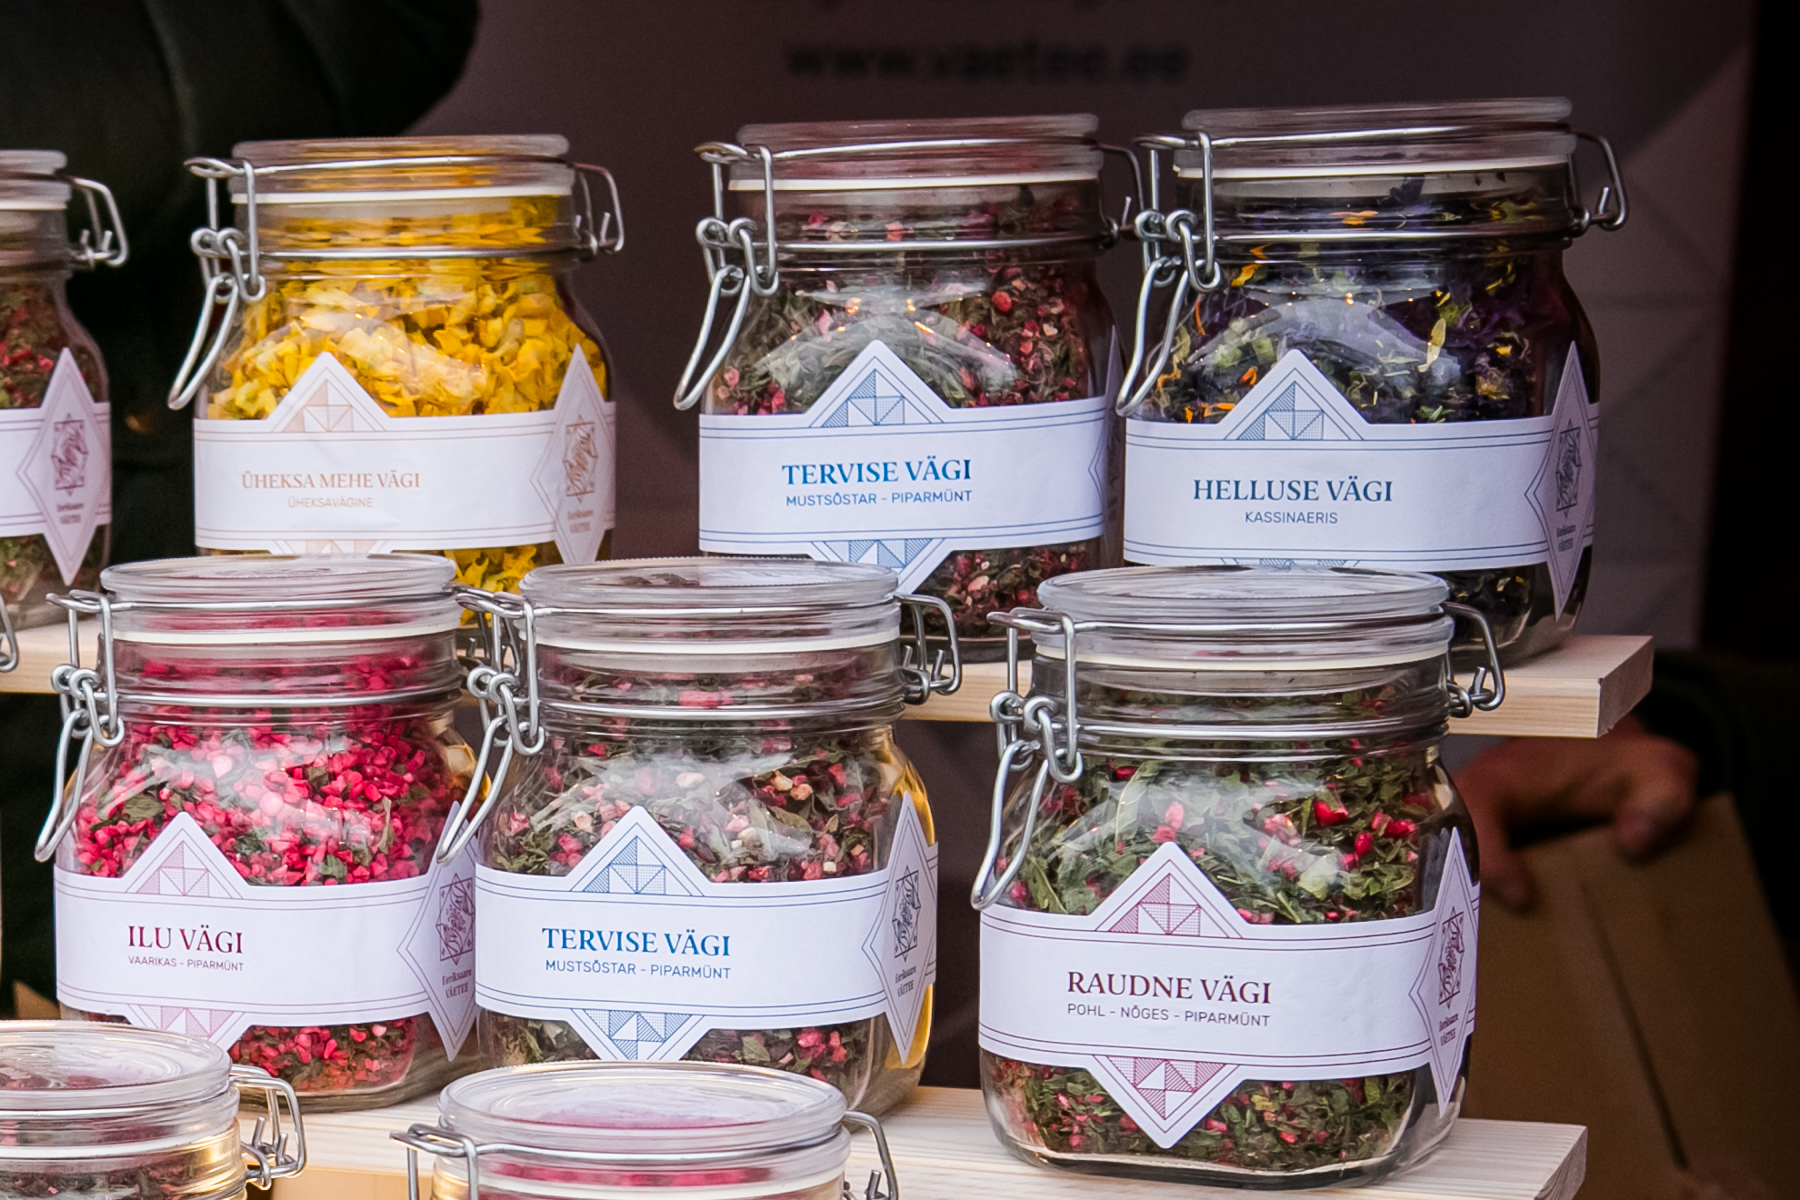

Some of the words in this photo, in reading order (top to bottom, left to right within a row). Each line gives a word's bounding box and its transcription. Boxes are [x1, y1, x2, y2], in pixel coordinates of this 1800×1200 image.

[242, 471, 315, 489] ÜHEKSA
[319, 473, 373, 489] MEHE
[377, 471, 420, 489] VÄGI
[782, 460, 898, 485] TERVISE
[907, 455, 972, 482] VÄGI
[786, 488, 876, 506] MUSTSÕSTAR
[892, 488, 972, 503] PIPARMÜNT
[1193, 479, 1319, 501] HELLUSE
[1326, 475, 1393, 501] VÄGI
[288, 494, 373, 508] ÜHEKSAVÄGINE
[1245, 511, 1338, 524] KASSINAERIS
[128, 925, 172, 949] ILU
[179, 925, 243, 954] VÄGI
[542, 928, 658, 953] TERVISE
[664, 929, 731, 956] VÄGI
[128, 956, 177, 968] VAARIKAS
[187, 958, 244, 972] PIPARMÜNT
[545, 958, 636, 976] MUSTSÕSTAR
[651, 962, 731, 979] PIPARMÜNT
[1068, 971, 1193, 1000] RAUDNE
[1200, 975, 1271, 1004] VÄGI
[1068, 1003, 1106, 1018] POHL
[1120, 1003, 1169, 1021] NÕGES
[1184, 1009, 1270, 1027] PIPARMÜNT
